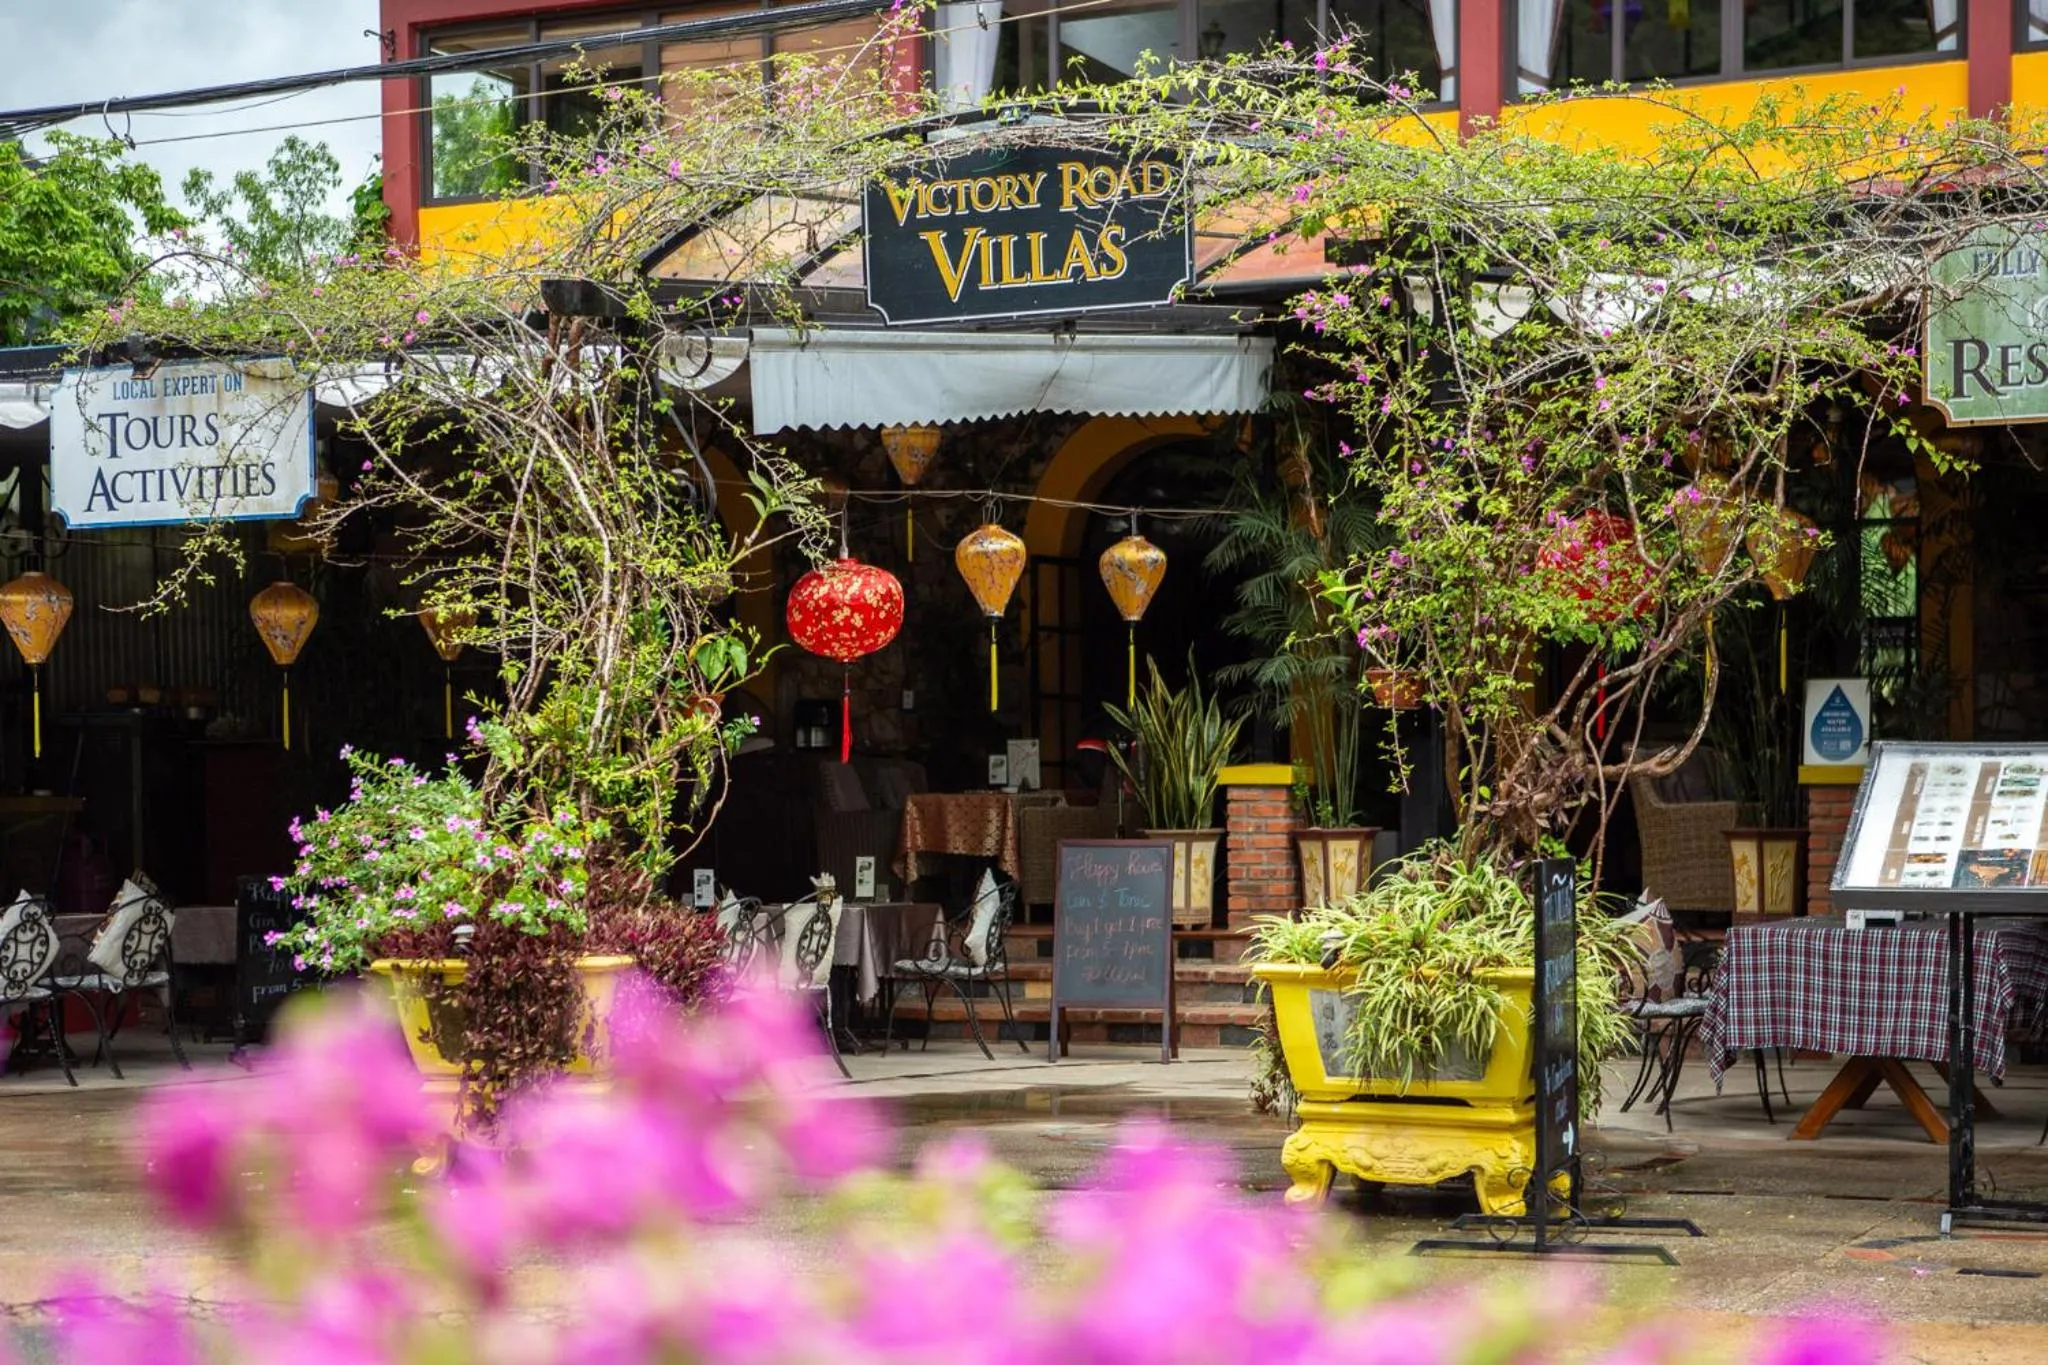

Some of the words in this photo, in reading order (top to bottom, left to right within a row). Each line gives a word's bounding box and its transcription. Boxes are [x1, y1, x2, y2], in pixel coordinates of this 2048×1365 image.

[883, 171, 1047, 227] VICTORY
[1057, 160, 1173, 213] ROAD
[919, 223, 1128, 303] VILLAS
[113, 379, 157, 401] LOCAL
[163, 374, 218, 397] EXPERT
[224, 373, 242, 392] ON
[97, 412, 219, 459] TOURS
[84, 462, 277, 512] ACTIVITIES
